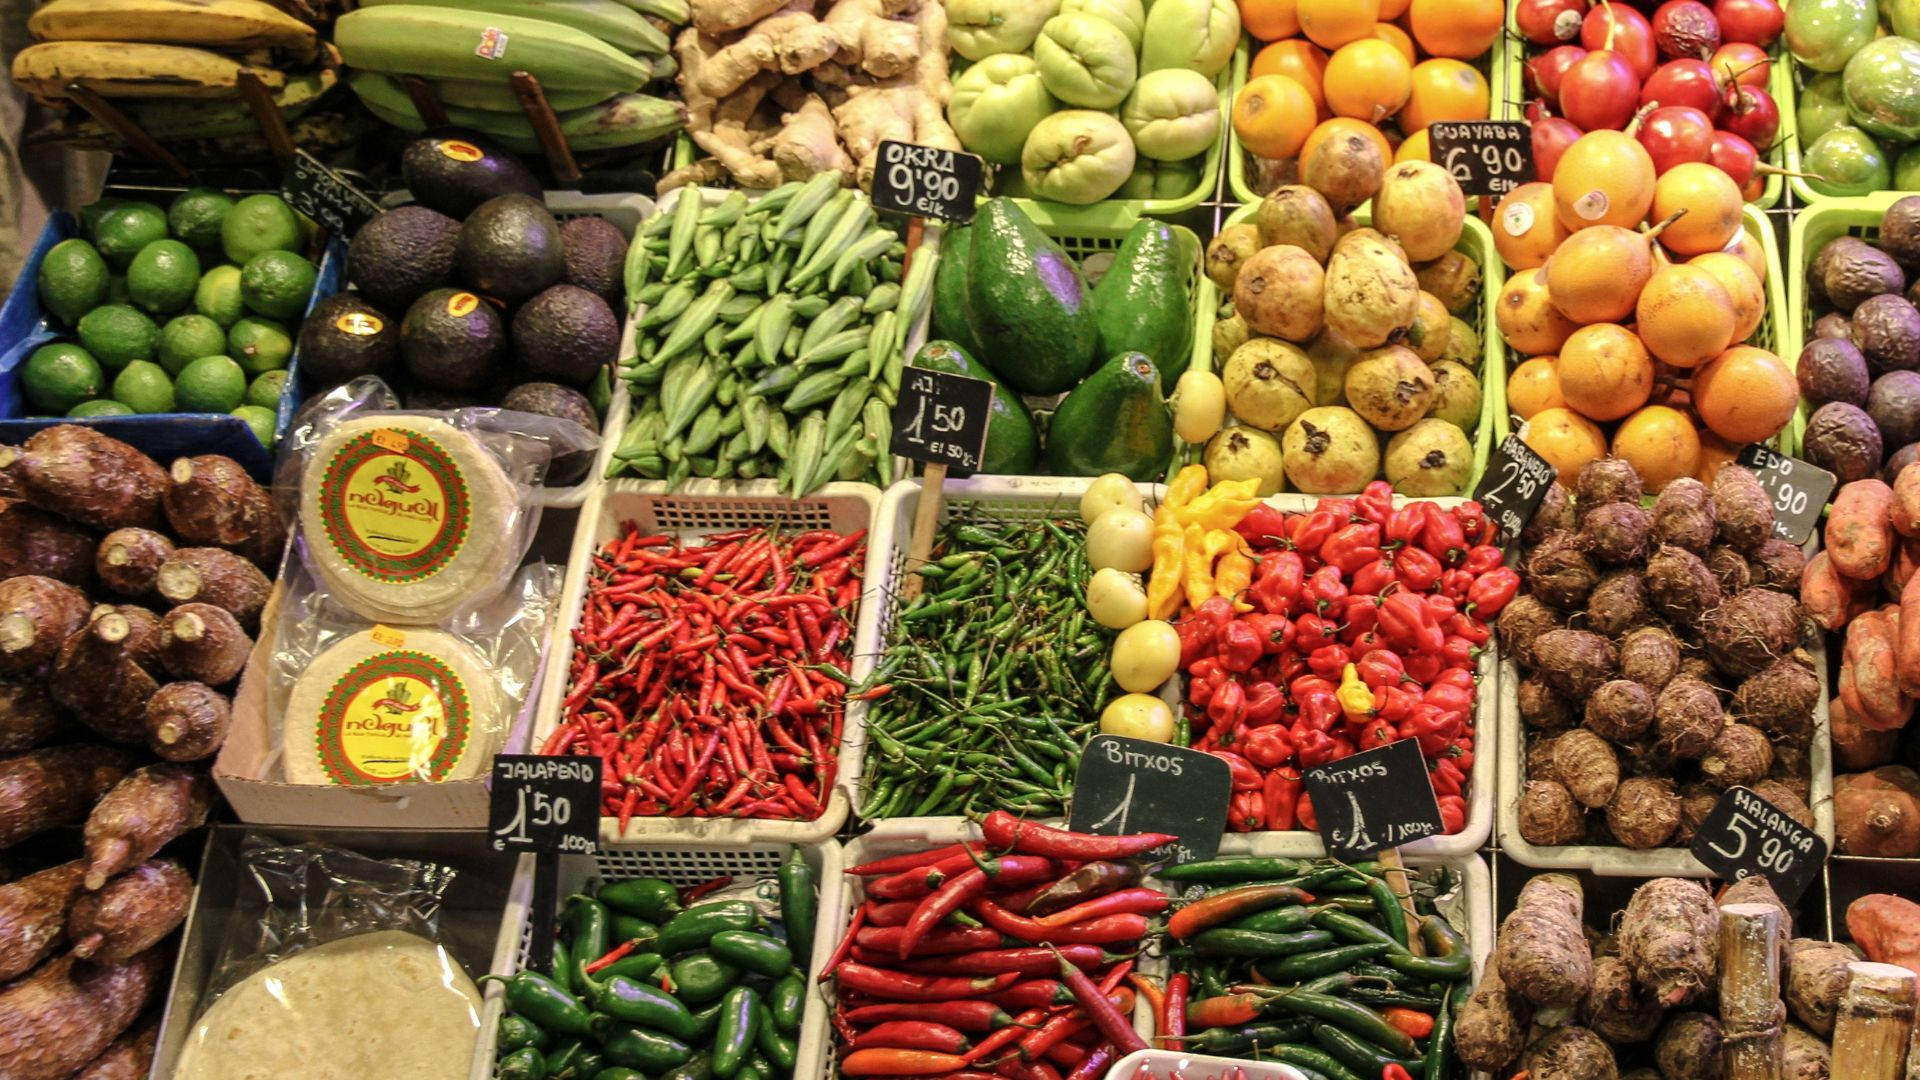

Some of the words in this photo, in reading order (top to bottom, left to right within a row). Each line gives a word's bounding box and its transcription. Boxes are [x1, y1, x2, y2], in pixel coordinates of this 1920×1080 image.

[1433, 124, 1520, 140] GUAYABA
[886, 143, 955, 173] OKRA
[1446, 144, 1523, 180] 6'90
[888, 163, 959, 206] 9'90
[903, 395, 965, 444] 1'50
[1502, 437, 1551, 485] HABANERO
[1753, 449, 1793, 475] EDO
[1482, 462, 1537, 504] 2'50
[1756, 470, 1808, 514] '90
[349, 489, 439, 522] nagual
[346, 714, 438, 736] nagul
[498, 761, 594, 783] JALAPEÑO
[495, 784, 571, 843] 1'50
[1735, 789, 1814, 853] MALANGA
[1708, 813, 1794, 873] 5'90
